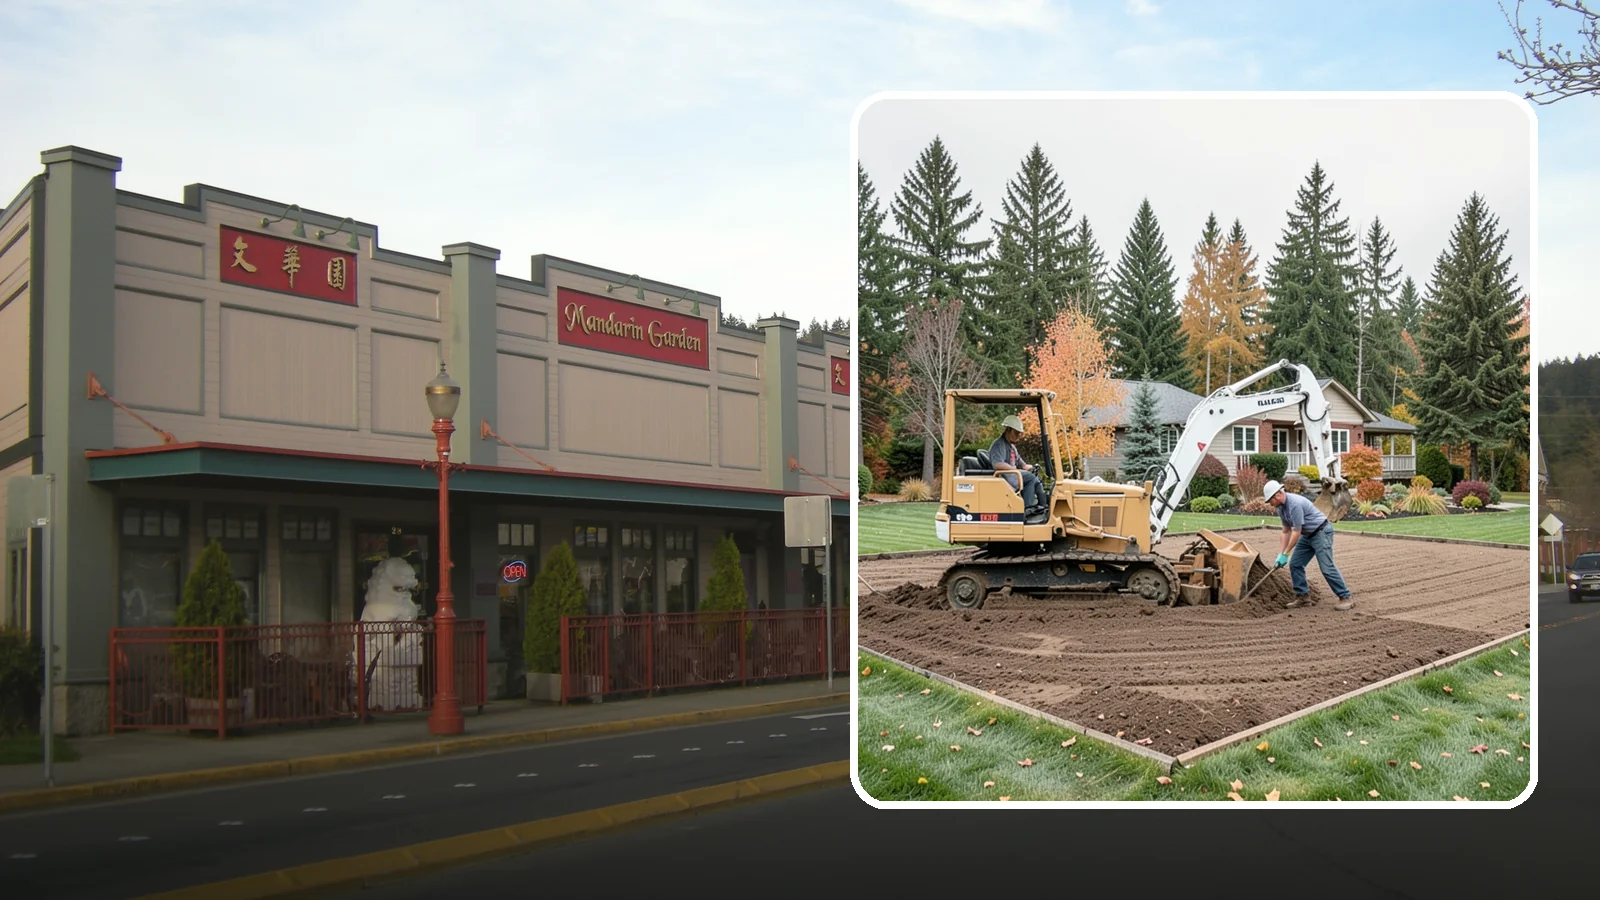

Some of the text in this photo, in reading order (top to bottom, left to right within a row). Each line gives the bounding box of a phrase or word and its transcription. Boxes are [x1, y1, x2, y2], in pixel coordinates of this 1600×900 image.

[231, 235, 346, 291] 文華園
[564, 302, 702, 352] Mandarin Garden
[503, 565, 527, 578] OPEN
